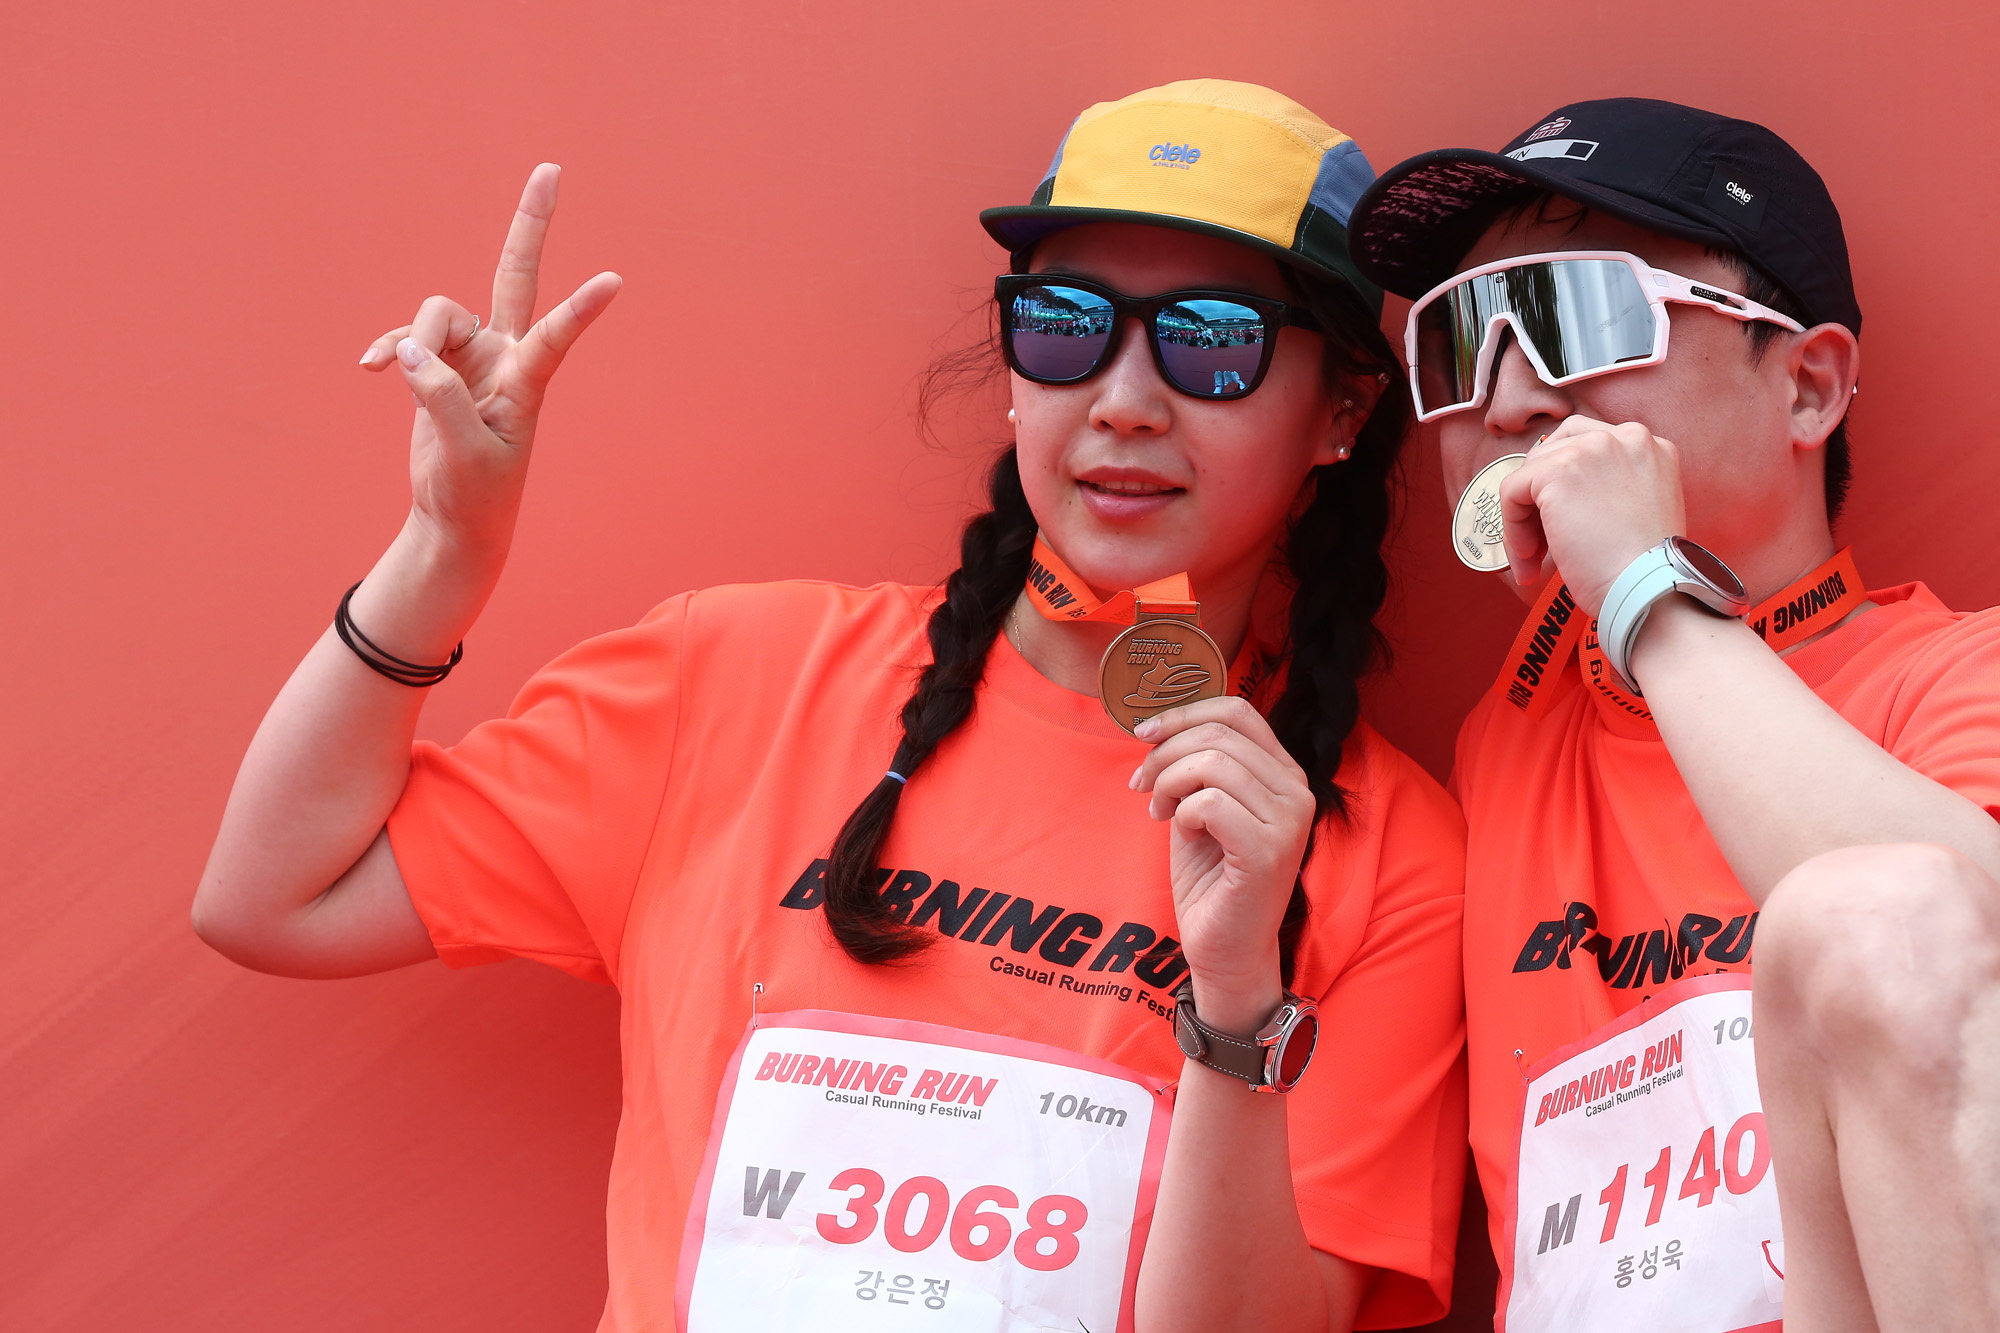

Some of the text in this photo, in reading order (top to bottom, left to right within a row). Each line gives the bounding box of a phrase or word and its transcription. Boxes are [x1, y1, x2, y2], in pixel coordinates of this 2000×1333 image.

[1149, 141, 1201, 164] ciele
[1726, 181, 1751, 203] ciele
[1774, 570, 1847, 634] BURNING
[1127, 642, 1183, 655] BURNING
[1127, 653, 1156, 665] RUN
[1677, 912, 1760, 965] RU
[990, 956, 1175, 1023] Casual Running Fest
[755, 1052, 999, 1107] BURNING RUN
[1534, 1028, 1683, 1128] BURNING RUN
[1585, 1065, 1684, 1118] Casual Running Festival
[825, 1090, 982, 1121] Casual Running Festival
[1039, 1091, 1128, 1128] 10km
[1537, 1112, 1773, 1255] M 1140
[742, 1166, 1088, 1271] W 3068
[854, 1269, 950, 1310] 강은정
[1613, 1239, 1684, 1289] 홍성욱
